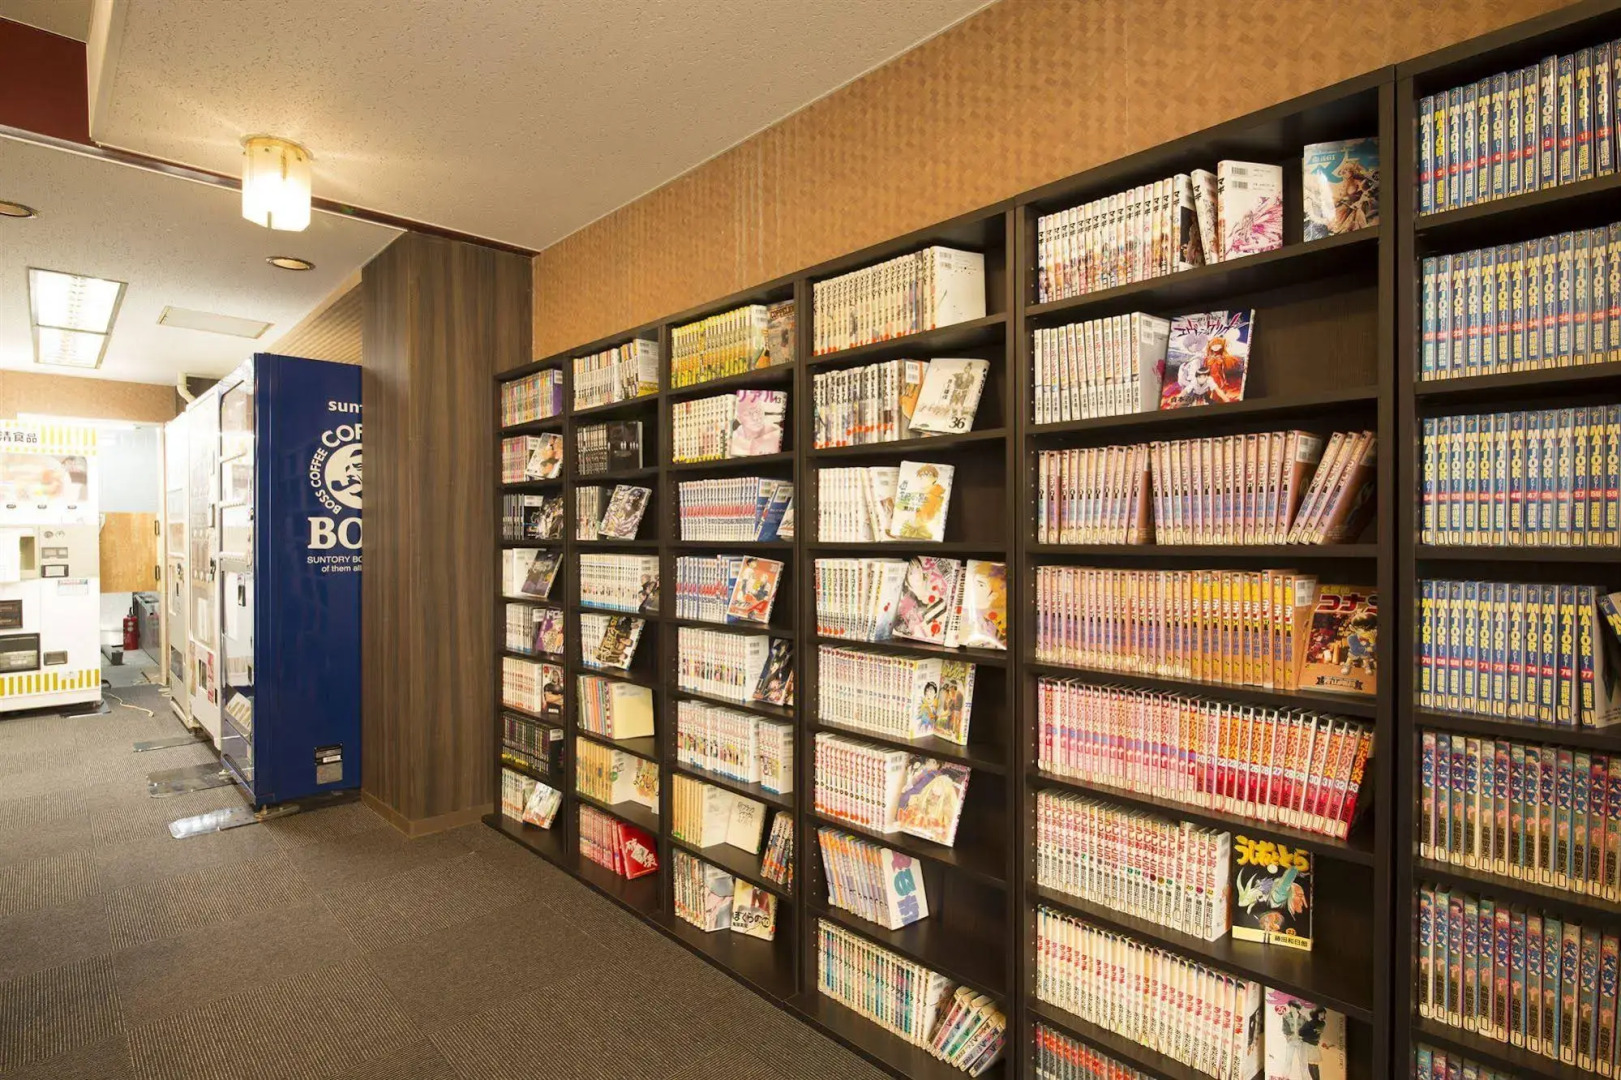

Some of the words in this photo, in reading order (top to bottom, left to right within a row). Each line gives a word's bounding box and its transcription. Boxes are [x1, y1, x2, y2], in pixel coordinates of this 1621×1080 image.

[1524, 84, 1536, 134] MAJOR
[1542, 75, 1553, 125] MAJOR
[1560, 73, 1571, 125] MAJOR
[1578, 66, 1590, 119] MAJOR
[1596, 62, 1608, 114] MAJOR
[1421, 114, 1431, 160] MAJOR
[1435, 110, 1444, 157] MAJOR
[1450, 105, 1460, 153] MAJOR
[1464, 101, 1474, 149] MAJOR
[1479, 95, 1490, 144] MAJOR
[1492, 91, 1503, 140] MAJOR
[1509, 88, 1519, 138] MAJOR
[1193, 185, 1201, 200] マギ
[1218, 178, 1225, 194] マギ
[1468, 267, 1478, 315] MAJOR
[1482, 265, 1493, 313] MAJOR
[1497, 262, 1508, 310] MAJOR
[1512, 261, 1522, 310] MAJOR
[1527, 257, 1539, 306] MAJOR
[1543, 253, 1555, 303] MAJOR
[1558, 250, 1571, 300] MAJOR
[1575, 248, 1587, 299] MAJOR
[1592, 245, 1606, 297] MAJOR
[1609, 241, 1620, 293] MAJOR
[1424, 273, 1434, 320] MAJOR
[1438, 272, 1448, 319] MAJOR
[1453, 269, 1464, 316] MAJOR
[328, 401, 362, 414] sun
[949, 417, 966, 429] 36
[309, 448, 328, 488] COFFEE
[1424, 435, 1435, 480] MAJOR
[1438, 435, 1449, 480] MAJOR
[1452, 433, 1463, 480] MAJOR
[1466, 432, 1476, 480] MAJOR
[1480, 432, 1491, 480] MAJOR
[1496, 432, 1506, 479] MAJOR
[1511, 430, 1523, 479] MAJOR
[1527, 429, 1539, 477] MAJOR
[1542, 429, 1554, 478] MAJOR
[1558, 427, 1571, 477] MAJOR
[1575, 426, 1588, 476] MAJOR
[1590, 425, 1604, 476] MAJOR
[1606, 424, 1620, 475] MAJOR
[315, 490, 342, 514] BOSS
[307, 556, 350, 564] SUNTORY
[1422, 598, 1433, 644] MAJOR
[1436, 599, 1447, 645] MAJOR
[1450, 599, 1461, 646] MAJOR
[1464, 600, 1476, 646] MAJOR
[1479, 601, 1490, 649] MAJOR
[1494, 602, 1506, 650] MAJOR
[1510, 602, 1522, 650] MAJOR
[1527, 603, 1539, 652] MAJOR
[1542, 604, 1554, 653] MAJOR
[1561, 604, 1574, 654] MAJOR
[1579, 605, 1592, 656] MAJOR
[1335, 780, 1345, 789] 32
